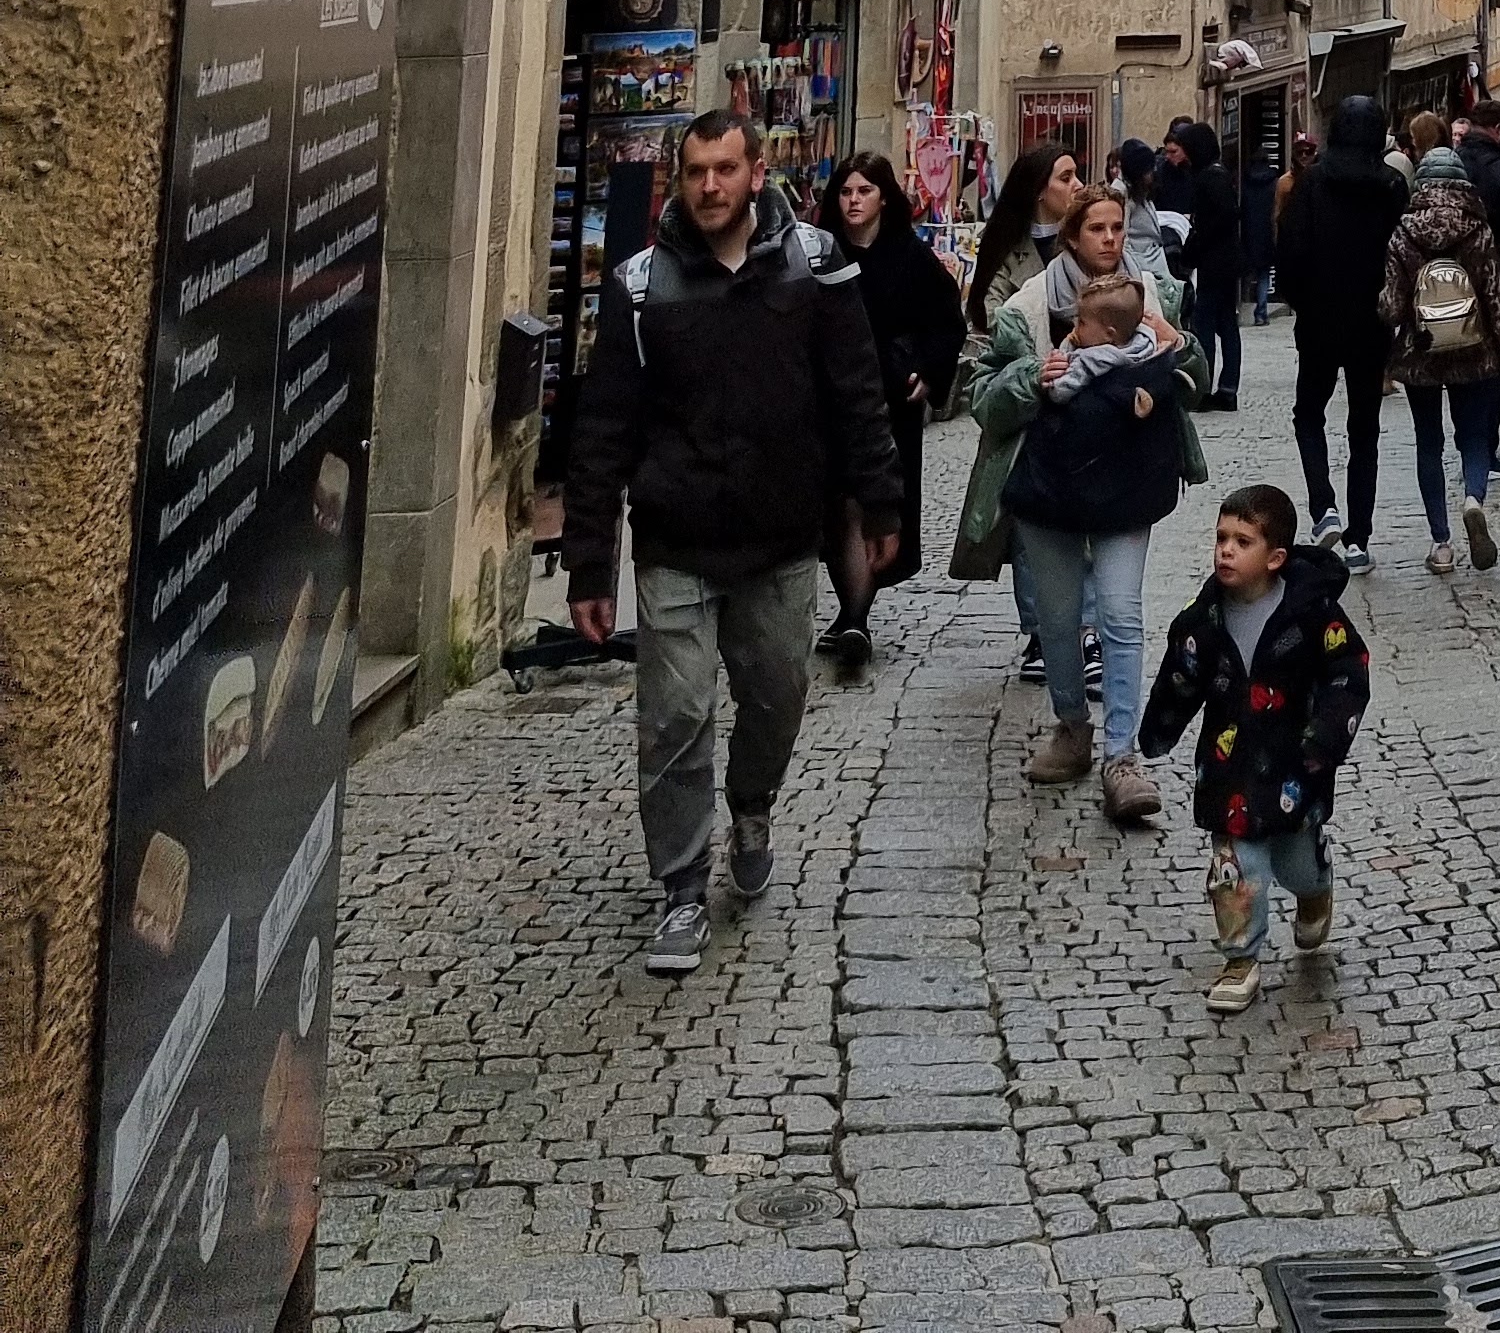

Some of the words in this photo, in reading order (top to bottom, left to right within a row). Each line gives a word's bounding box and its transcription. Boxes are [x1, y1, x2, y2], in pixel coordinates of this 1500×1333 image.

[188, 126, 223, 178] Jambon
[299, 136, 318, 174] Kebab
[185, 196, 218, 242] Chorizo
[294, 195, 319, 233] Jambon
[178, 274, 200, 319] Filet
[199, 263, 211, 306] de
[210, 259, 235, 297] bacon
[290, 253, 315, 294] Jambon
[172, 354, 181, 394] 3
[179, 333, 220, 388] fromages
[165, 419, 195, 470] Coppa
[158, 468, 208, 546] Mozzarella
